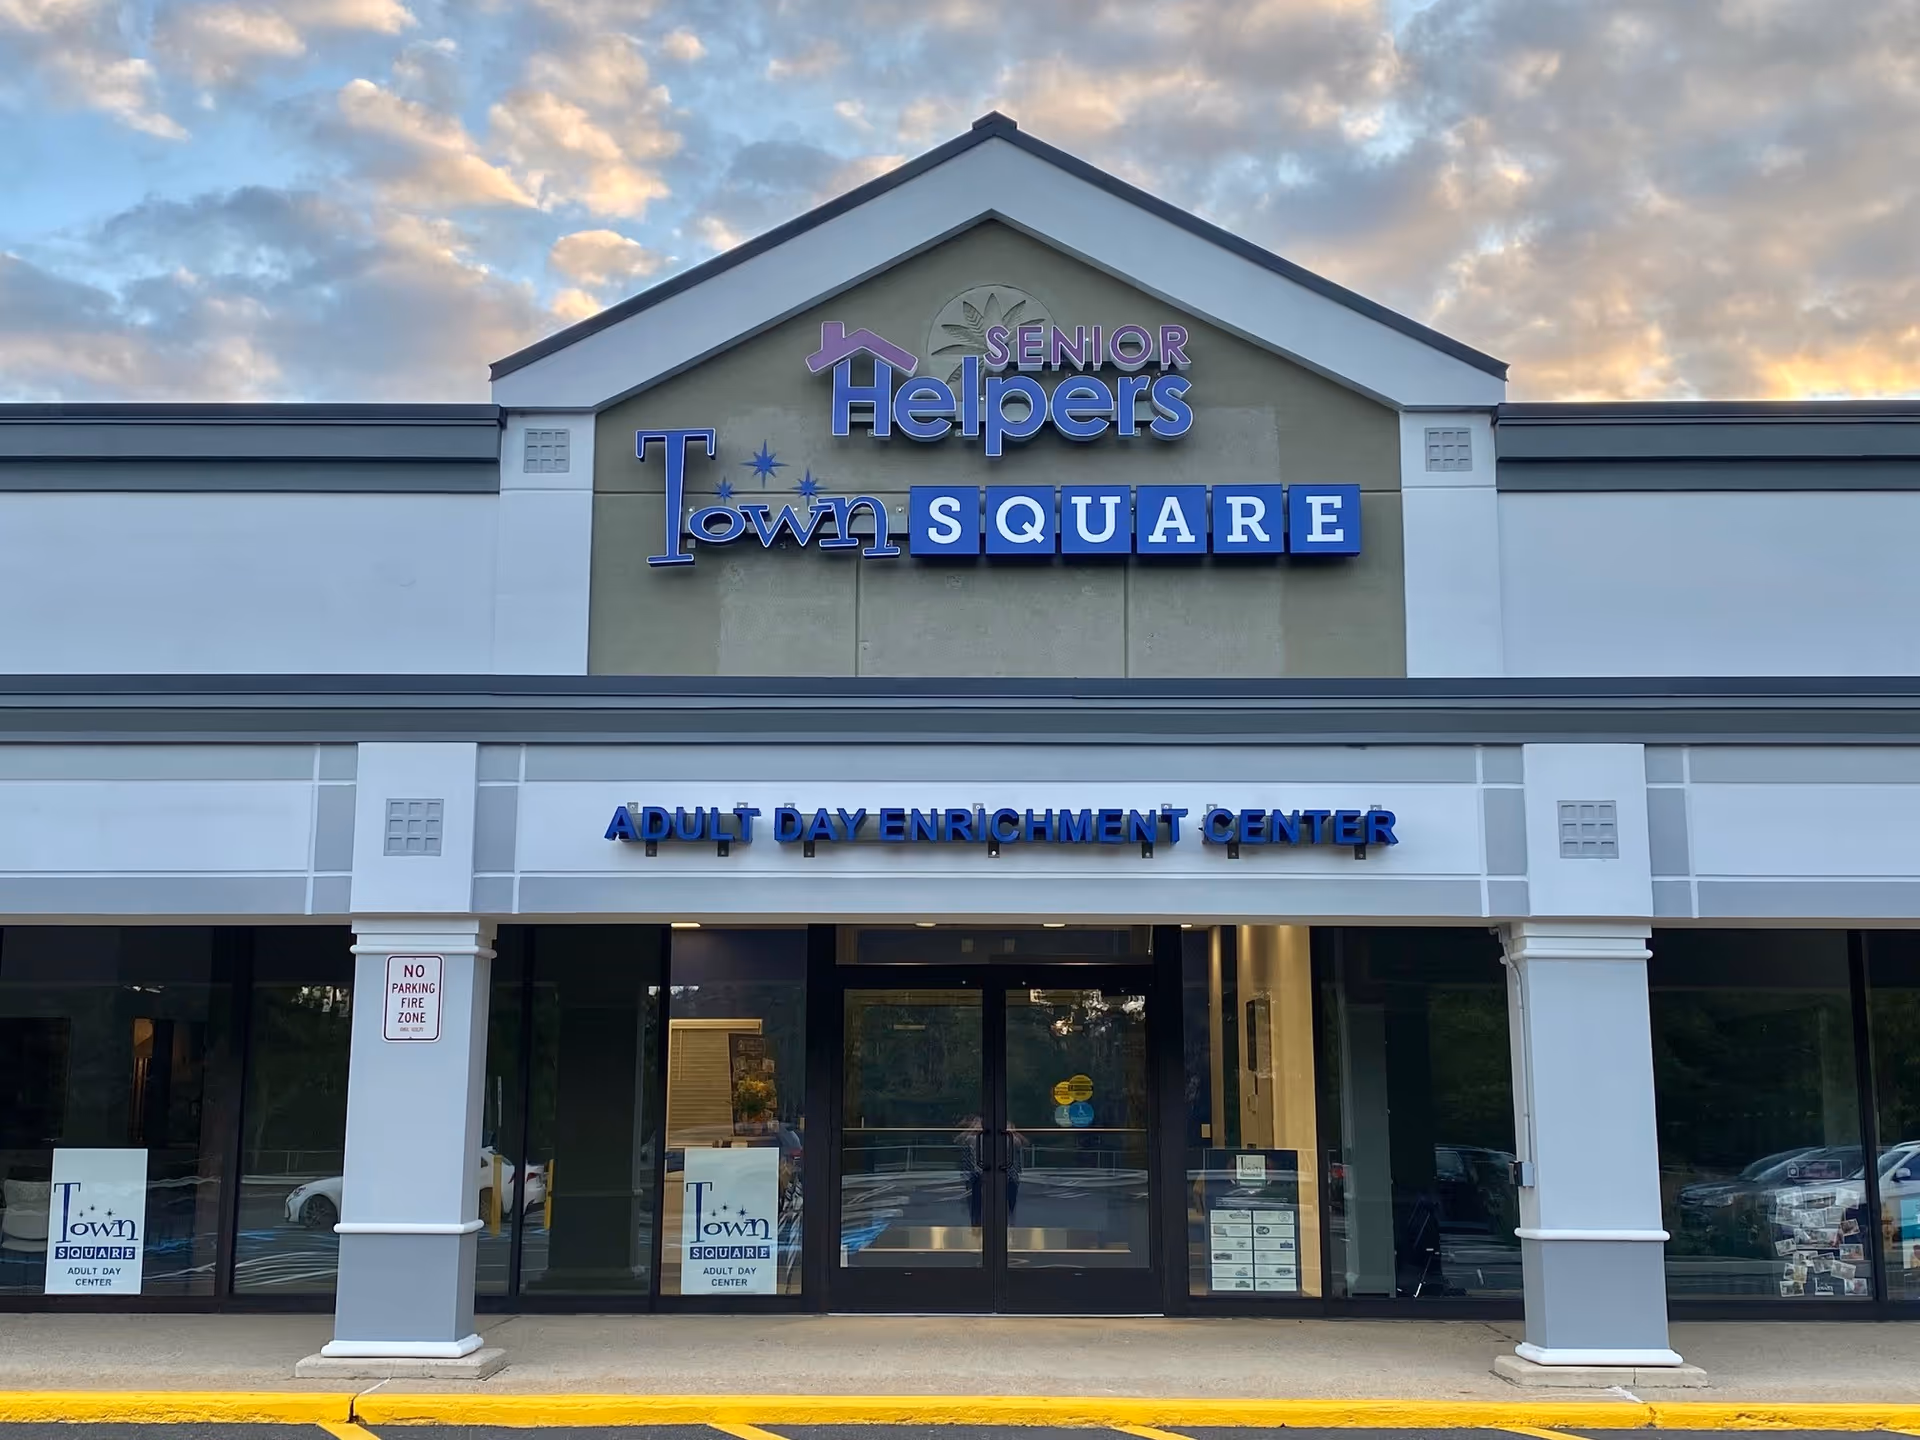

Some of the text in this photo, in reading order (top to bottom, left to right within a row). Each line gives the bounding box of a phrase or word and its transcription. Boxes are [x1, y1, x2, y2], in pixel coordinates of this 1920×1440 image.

[984, 324, 1192, 371] SENIOR
[830, 355, 1194, 457] Helpers
[635, 427, 1347, 567] Town SQUARE
[604, 806, 1399, 845] ADULT DAY ENRICHMENT CENTER
[404, 965, 425, 978] NO
[391, 983, 435, 994] PARKING
[401, 997, 425, 1009] FIRE
[397, 1012, 426, 1023] ZONE
[54, 1182, 139, 1244] Town
[686, 1181, 773, 1244] Town
[57, 1247, 135, 1259] SQUARE
[691, 1247, 769, 1259] SQUARE
[67, 1267, 122, 1275] ADULT DAY
[702, 1266, 757, 1275] ADULT DAY
[75, 1278, 112, 1286] CENTER
[711, 1278, 748, 1287] CENTER
